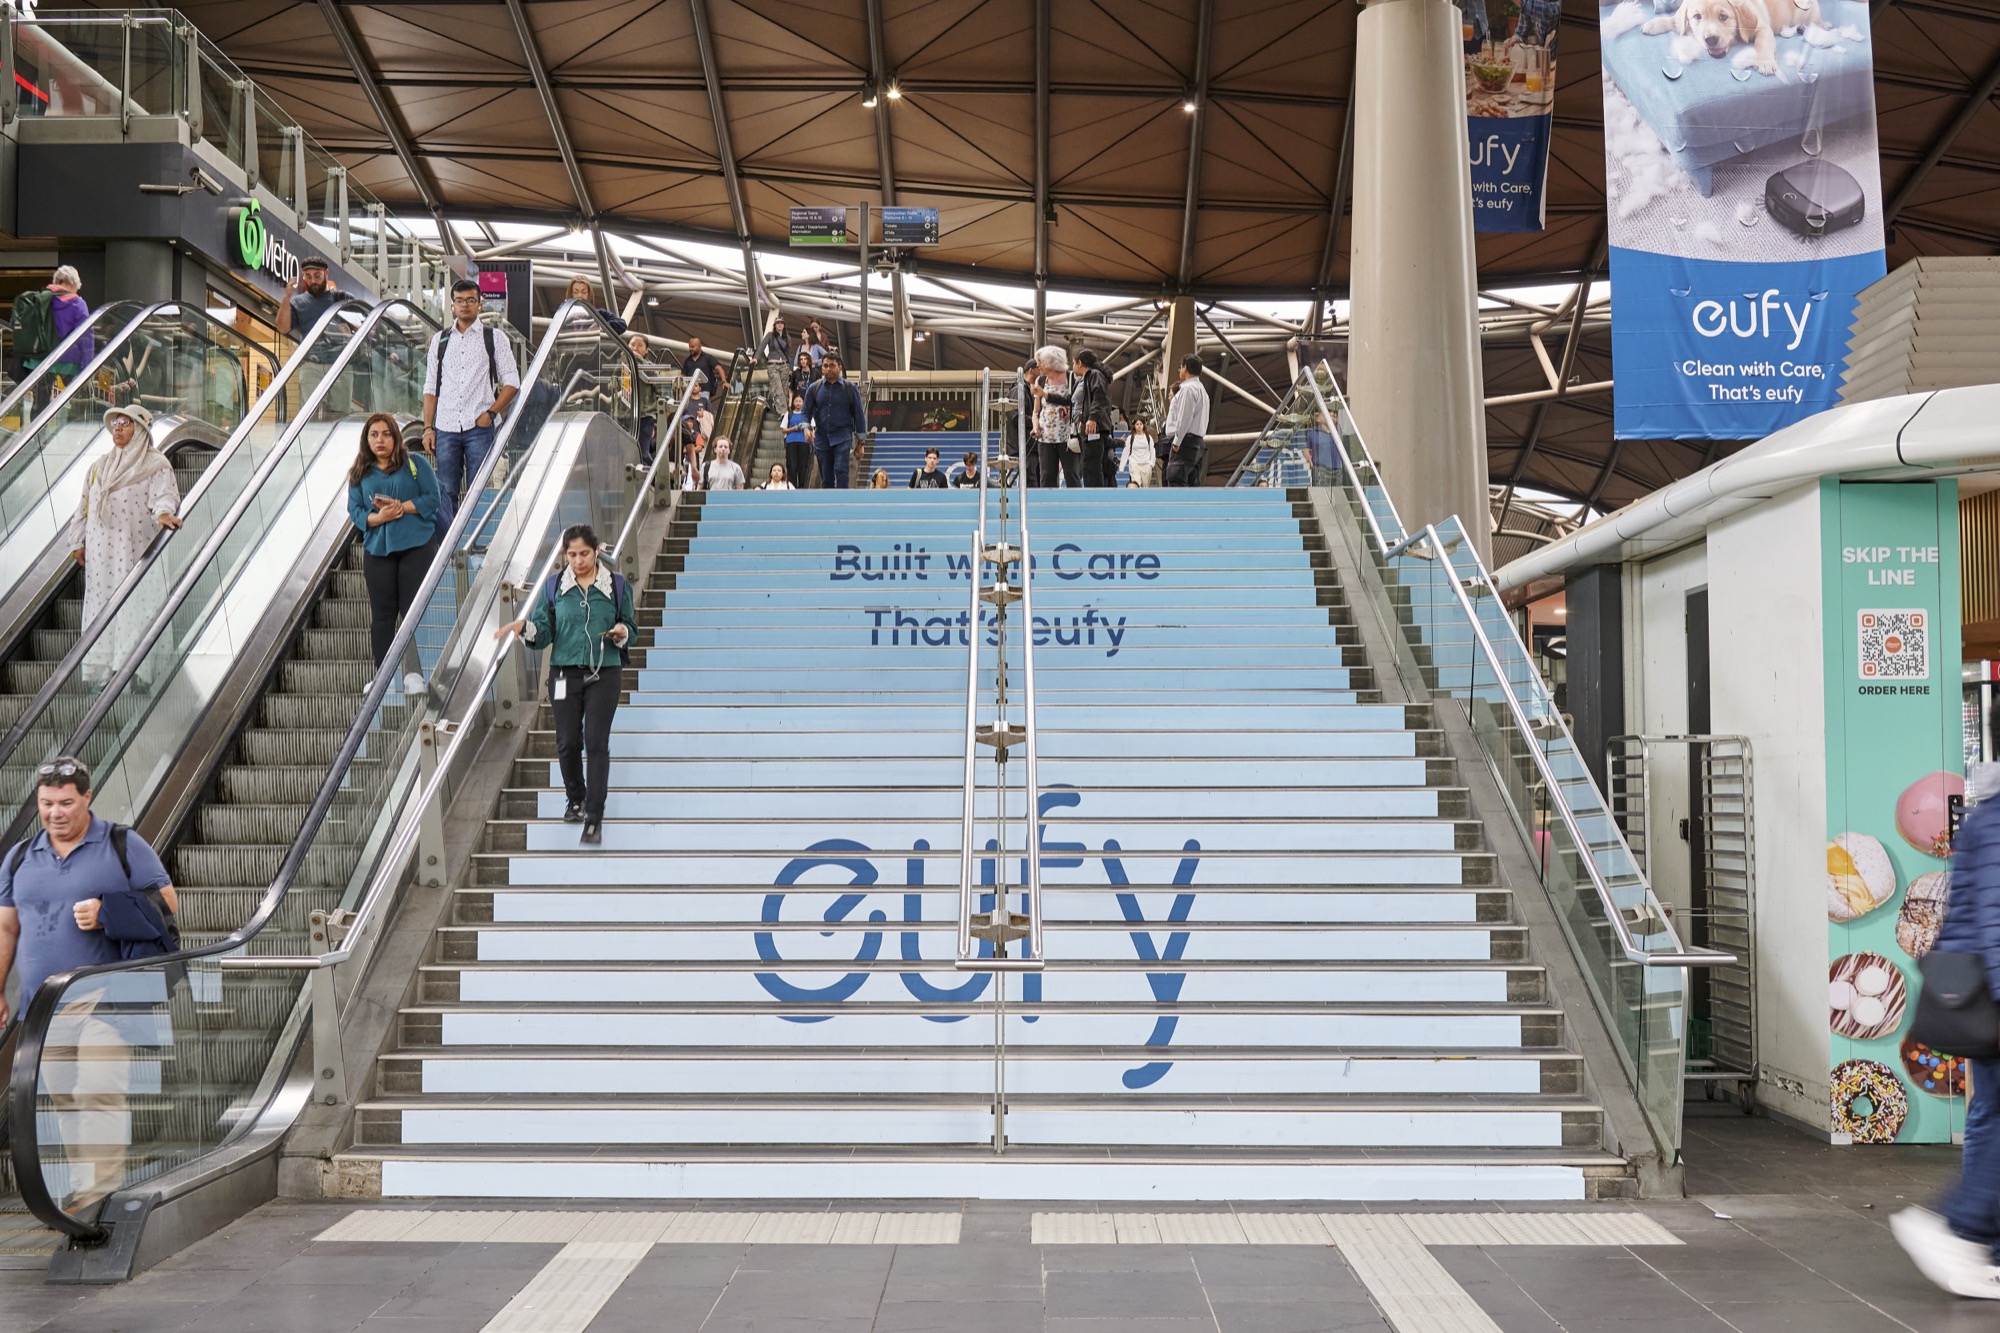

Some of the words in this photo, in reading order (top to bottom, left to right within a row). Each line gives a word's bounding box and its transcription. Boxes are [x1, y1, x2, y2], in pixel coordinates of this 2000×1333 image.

[1469, 134, 1521, 175] ufy
[1472, 181, 1498, 193] with
[1500, 182, 1532, 195] Care,
[1486, 198, 1513, 211] eufy
[262, 228, 299, 288] Metro
[1692, 288, 1811, 351] eufy
[1682, 360, 1735, 376] Clean
[1739, 361, 1776, 377] with
[1780, 361, 1825, 379] Care,
[1708, 384, 1761, 400] That's
[1765, 385, 1803, 404] eufy
[830, 542, 931, 581] Built
[1052, 542, 1161, 580] Care
[1842, 547, 1891, 564] SKIP
[1896, 547, 1940, 564] THE
[1868, 569, 1915, 586] LINE
[1030, 604, 1127, 657] eufy
[1858, 686, 1897, 695] ORDER
[1900, 686, 1930, 695] HERE
[753, 783, 1201, 1090] eufy
